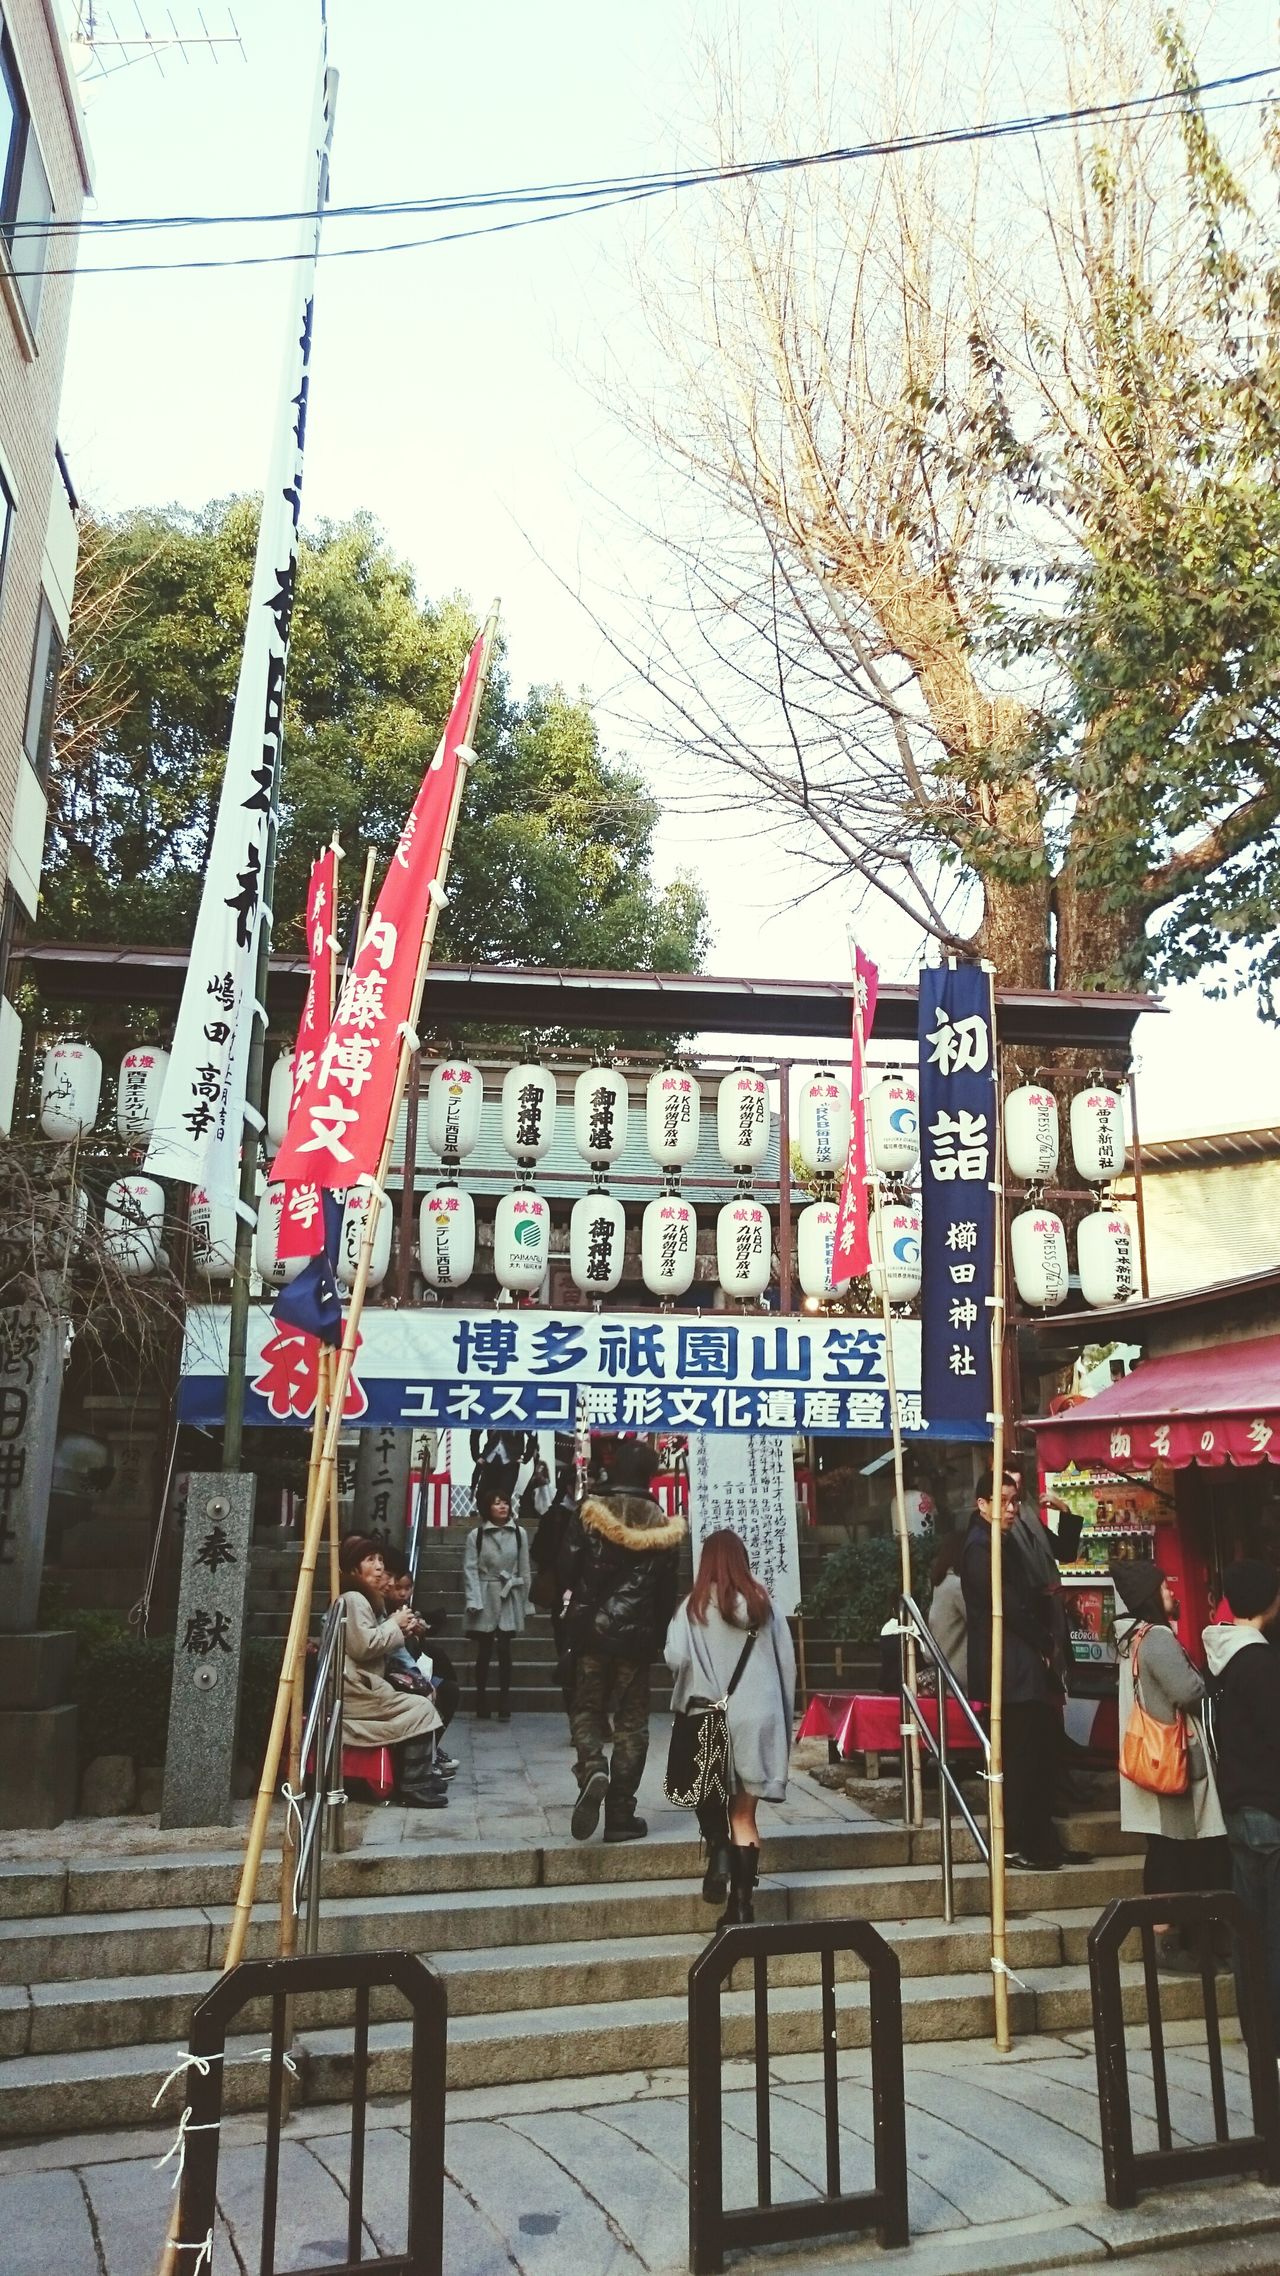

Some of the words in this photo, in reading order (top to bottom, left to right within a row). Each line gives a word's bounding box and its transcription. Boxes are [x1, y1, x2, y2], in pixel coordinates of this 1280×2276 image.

[296, 911, 398, 1164] 内藤博文
[124, 1055, 156, 1069] 献燈
[182, 971, 235, 1141] 嶋田高幸
[441, 1069, 472, 1084] 献燈
[662, 1078, 692, 1093] 献燈
[737, 1078, 766, 1094] 献燈
[809, 1084, 840, 1098] 献燈
[889, 1088, 916, 1102] 献燈
[925, 1006, 989, 1182] 初詣
[1028, 1093, 1055, 1109] 献燈
[1087, 1095, 1117, 1109] 献燈
[516, 1084, 544, 1146] 御神燈
[589, 1087, 616, 1149] 御神燈
[663, 1095, 679, 1147] 九州朝日放送
[680, 1095, 691, 1123] KBC
[737, 1095, 754, 1147] 九州朝日放送
[755, 1096, 765, 1123] KBC
[1038, 1106, 1050, 1132] DRESS
[443, 1096, 461, 1152] テレビ西日本
[815, 1107, 832, 1163] RKB毎日放送
[1096, 1108, 1114, 1169] 西日本新聞社
[428, 1198, 460, 1211] 献燈
[514, 1201, 543, 1216] 献燈
[660, 1207, 690, 1222] 献燈
[733, 1208, 763, 1223] 献燈
[893, 1216, 919, 1231] 献燈
[1033, 1219, 1061, 1234] 献燈
[587, 1217, 615, 1281] 御神燈
[660, 1223, 677, 1278] 九州朝日放送
[679, 1225, 689, 1252] KBC
[735, 1225, 752, 1279] 九州朝日放送
[752, 1226, 763, 1254] KBC
[1043, 1233, 1056, 1259] DRESS
[436, 1226, 454, 1283] テレビ西日本
[944, 1221, 978, 1378] 櫛田神社
[452, 1318, 887, 1384] 博多祇園山笠
[400, 1384, 930, 1432] ユネスコ無形文化遺産登録
[1070, 1631, 1100, 1642] GEORGIA
